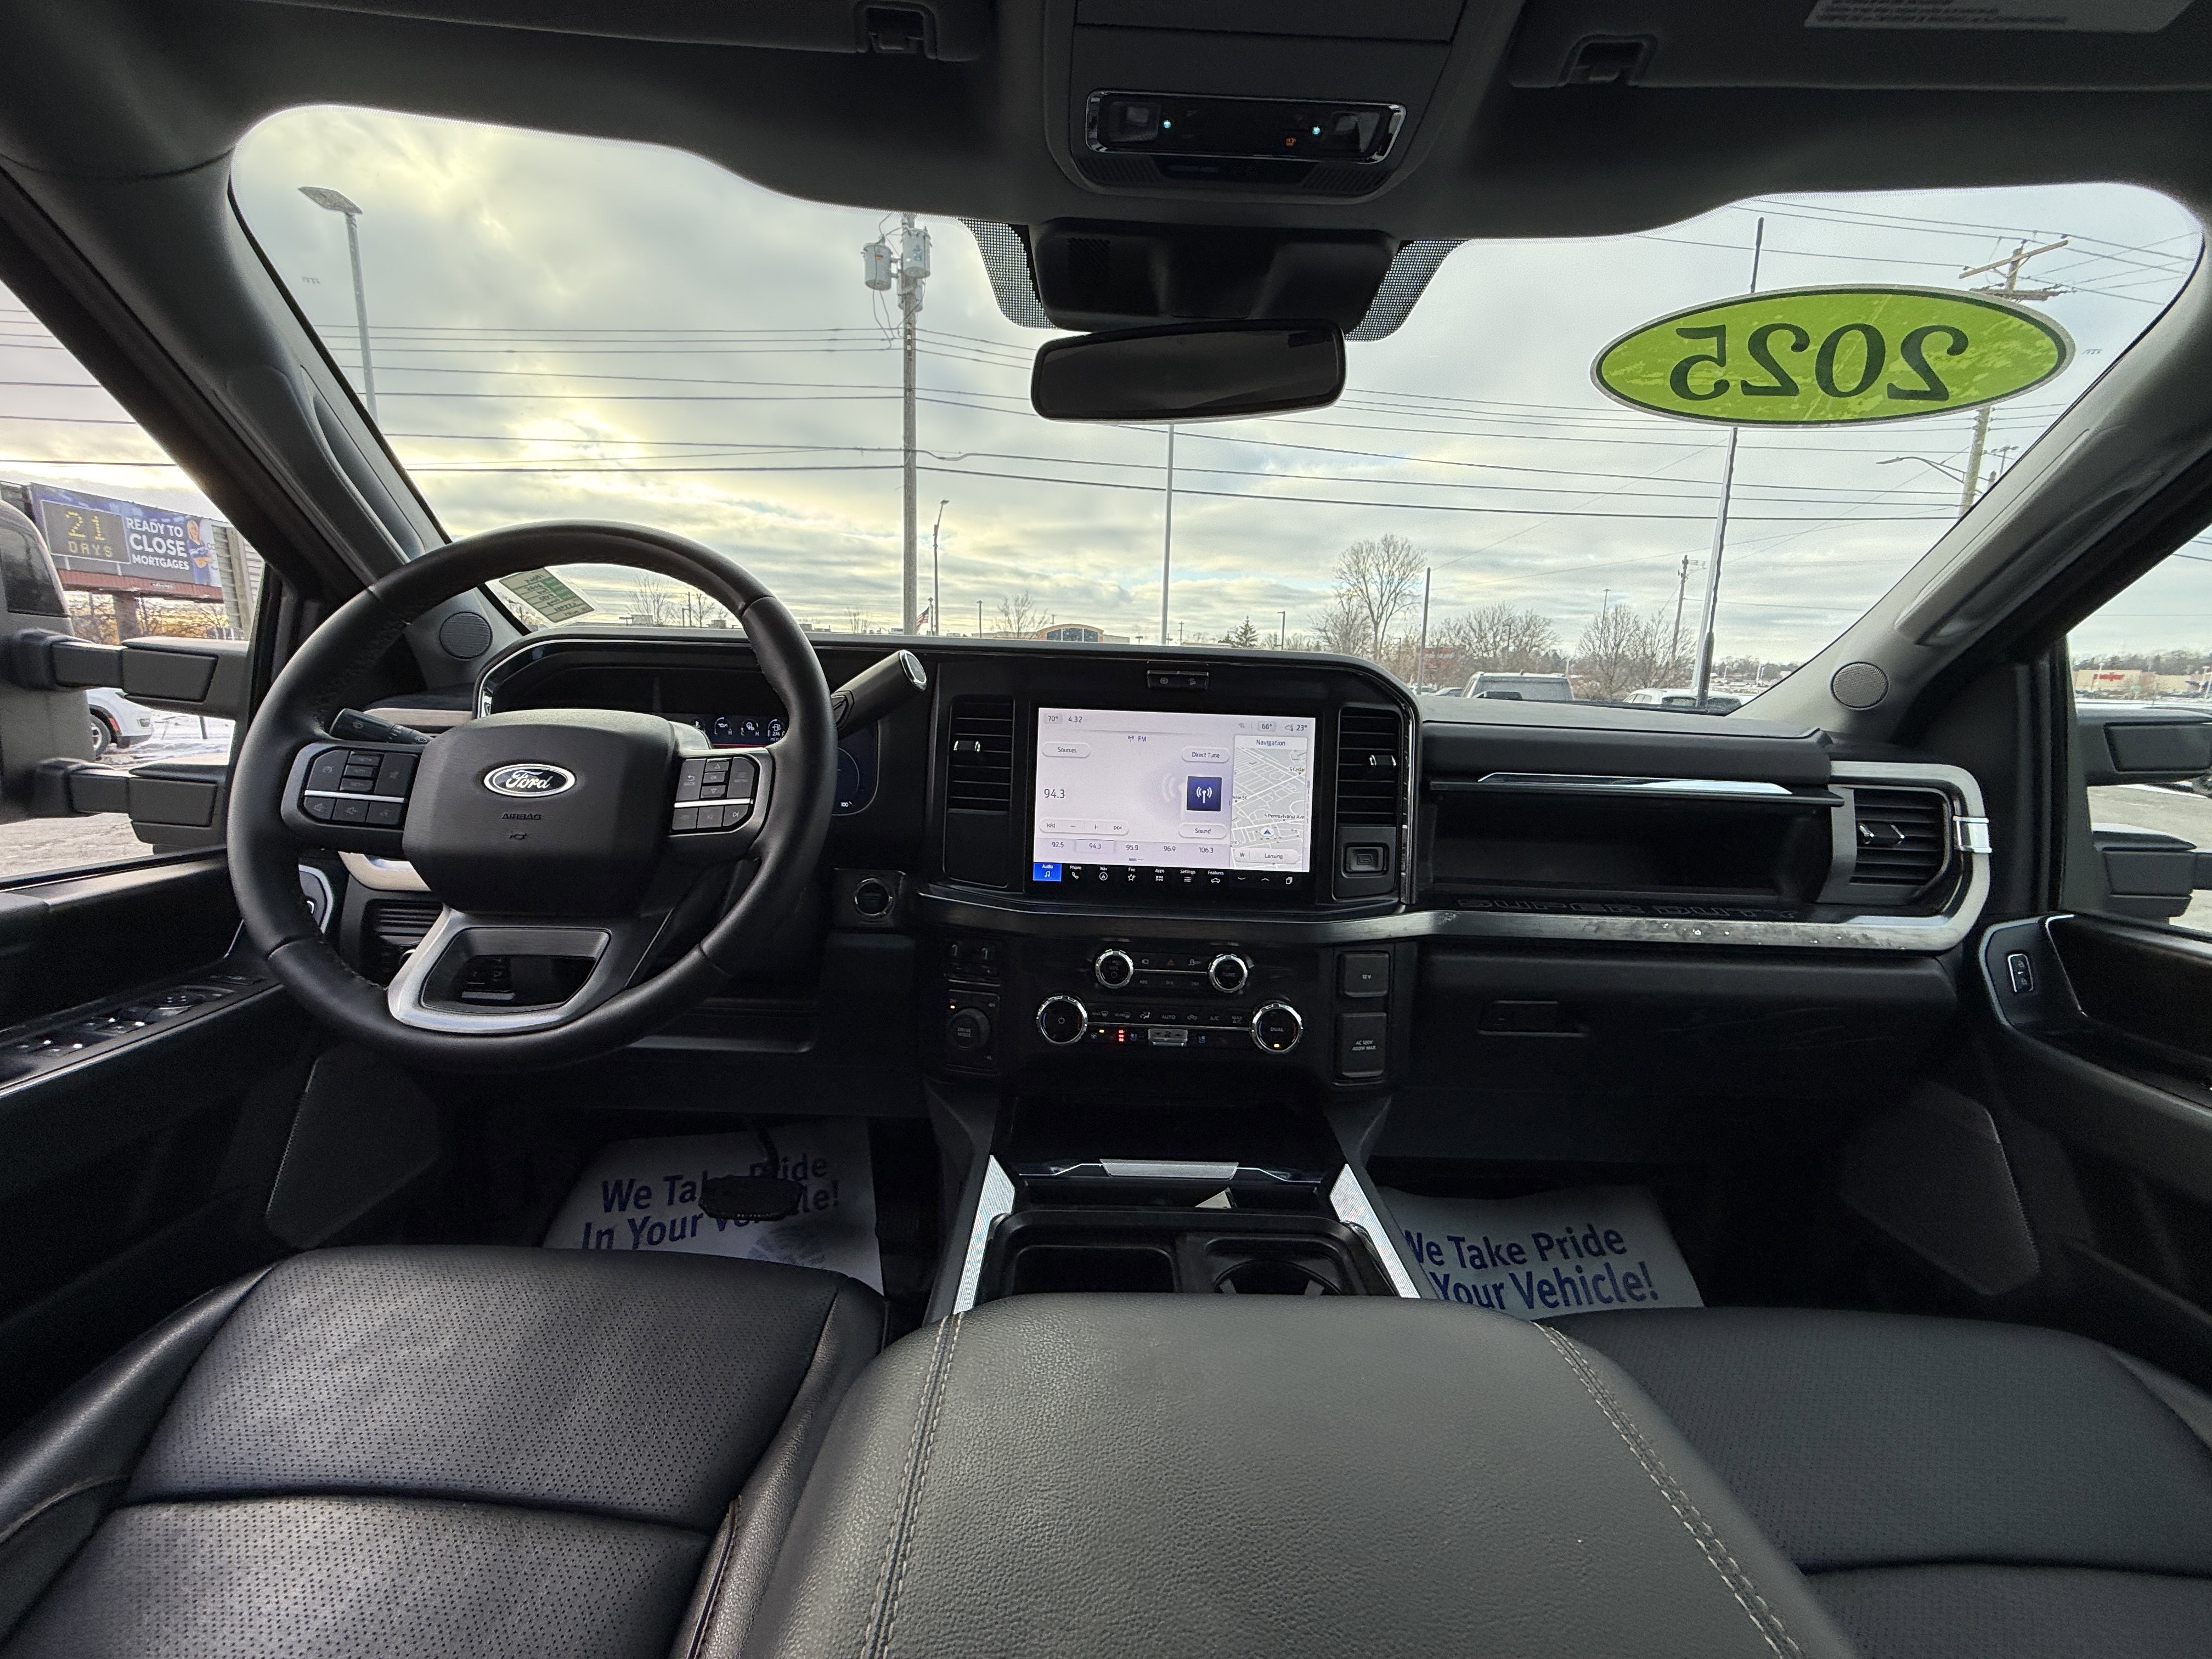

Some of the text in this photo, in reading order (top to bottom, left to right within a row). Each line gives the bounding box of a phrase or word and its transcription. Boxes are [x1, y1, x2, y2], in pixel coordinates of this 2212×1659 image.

[65, 511, 105, 541] 21
[126, 517, 184, 538] READY TO
[67, 540, 112, 557] DAYS
[129, 533, 187, 557] CLOSE
[132, 554, 190, 571] MORTGAGES
[505, 770, 554, 788] Ford
[1044, 789, 1065, 798] 94.3
[1457, 899, 1798, 918] SUPER DUTY
[601, 1178, 652, 1212] We
[664, 1171, 708, 1206] Ta
[582, 1213, 704, 1249] In Your
[1447, 1235, 1527, 1269] Take
[1532, 1223, 1628, 1262] Pride
[1429, 1261, 1658, 1310] Your Vehicle!
